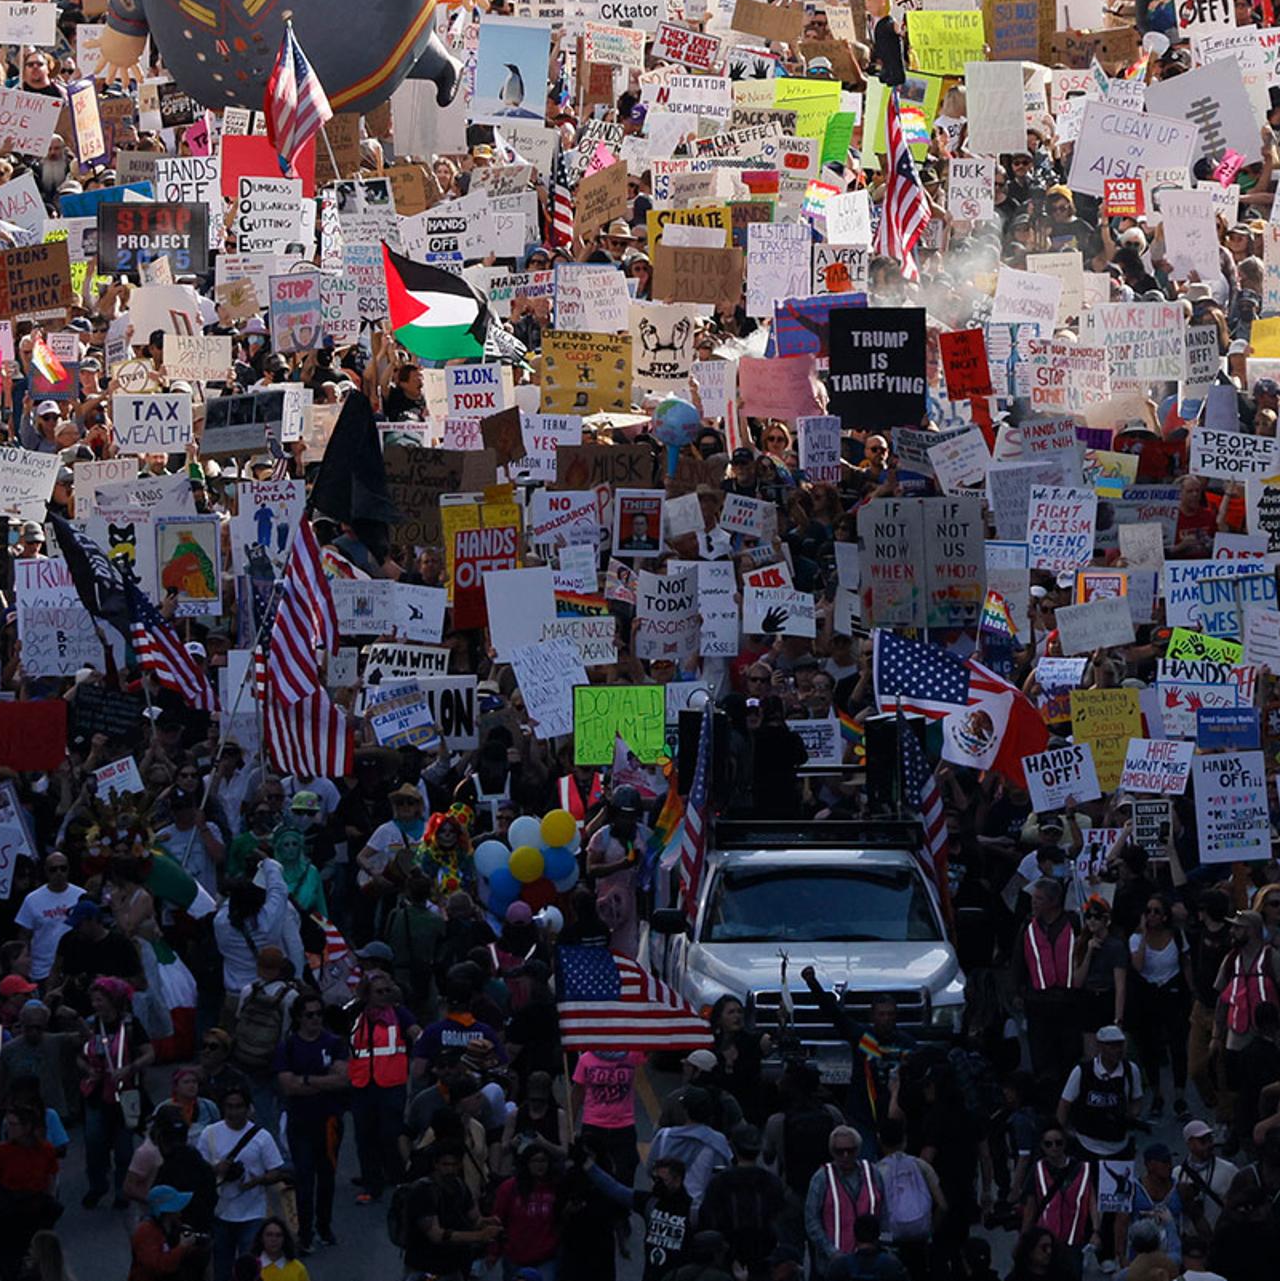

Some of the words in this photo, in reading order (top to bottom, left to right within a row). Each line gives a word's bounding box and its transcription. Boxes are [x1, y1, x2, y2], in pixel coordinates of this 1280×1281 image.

[1101, 114, 1149, 140] CLEAN
[1154, 124, 1180, 145] UP
[1128, 146, 1145, 159] ON
[156, 157, 218, 180] HANDS
[1090, 155, 1146, 178] AISLE
[165, 182, 209, 202] OFF
[1106, 180, 1136, 193] YOU
[1107, 191, 1136, 201] ARE
[1107, 206, 1137, 215] HERE
[116, 210, 192, 234] STOP
[426, 218, 467, 233] HANDS
[116, 234, 191, 251] PROJECT
[428, 237, 459, 252] OFF
[116, 250, 191, 271] 205
[673, 252, 732, 277] DEFUND
[677, 276, 731, 304] MUSK
[851, 330, 909, 349] TRUMP
[871, 352, 889, 371] IS
[453, 368, 499, 387] ELON,
[831, 374, 925, 395] TARIFFYING
[453, 391, 496, 410] FORK
[132, 400, 180, 422] TAX
[113, 424, 192, 444] WEALTH
[1202, 430, 1276, 455] PEOPLE
[1217, 447, 1255, 459] OVER
[1201, 453, 1272, 473] PROFIT
[242, 481, 249, 495] I
[252, 483, 282, 496] HAVE
[287, 482, 295, 492] A
[253, 491, 296, 504] DREAM
[884, 503, 903, 519] IF
[873, 523, 908, 538] NOT
[455, 529, 518, 559] HANDS
[874, 542, 909, 559] NOW
[870, 563, 915, 579] WHEN
[658, 578, 687, 595] NOT
[644, 595, 694, 611] TODAY
[1025, 746, 1085, 773] HANDS
[1042, 765, 1082, 785] OFF!
